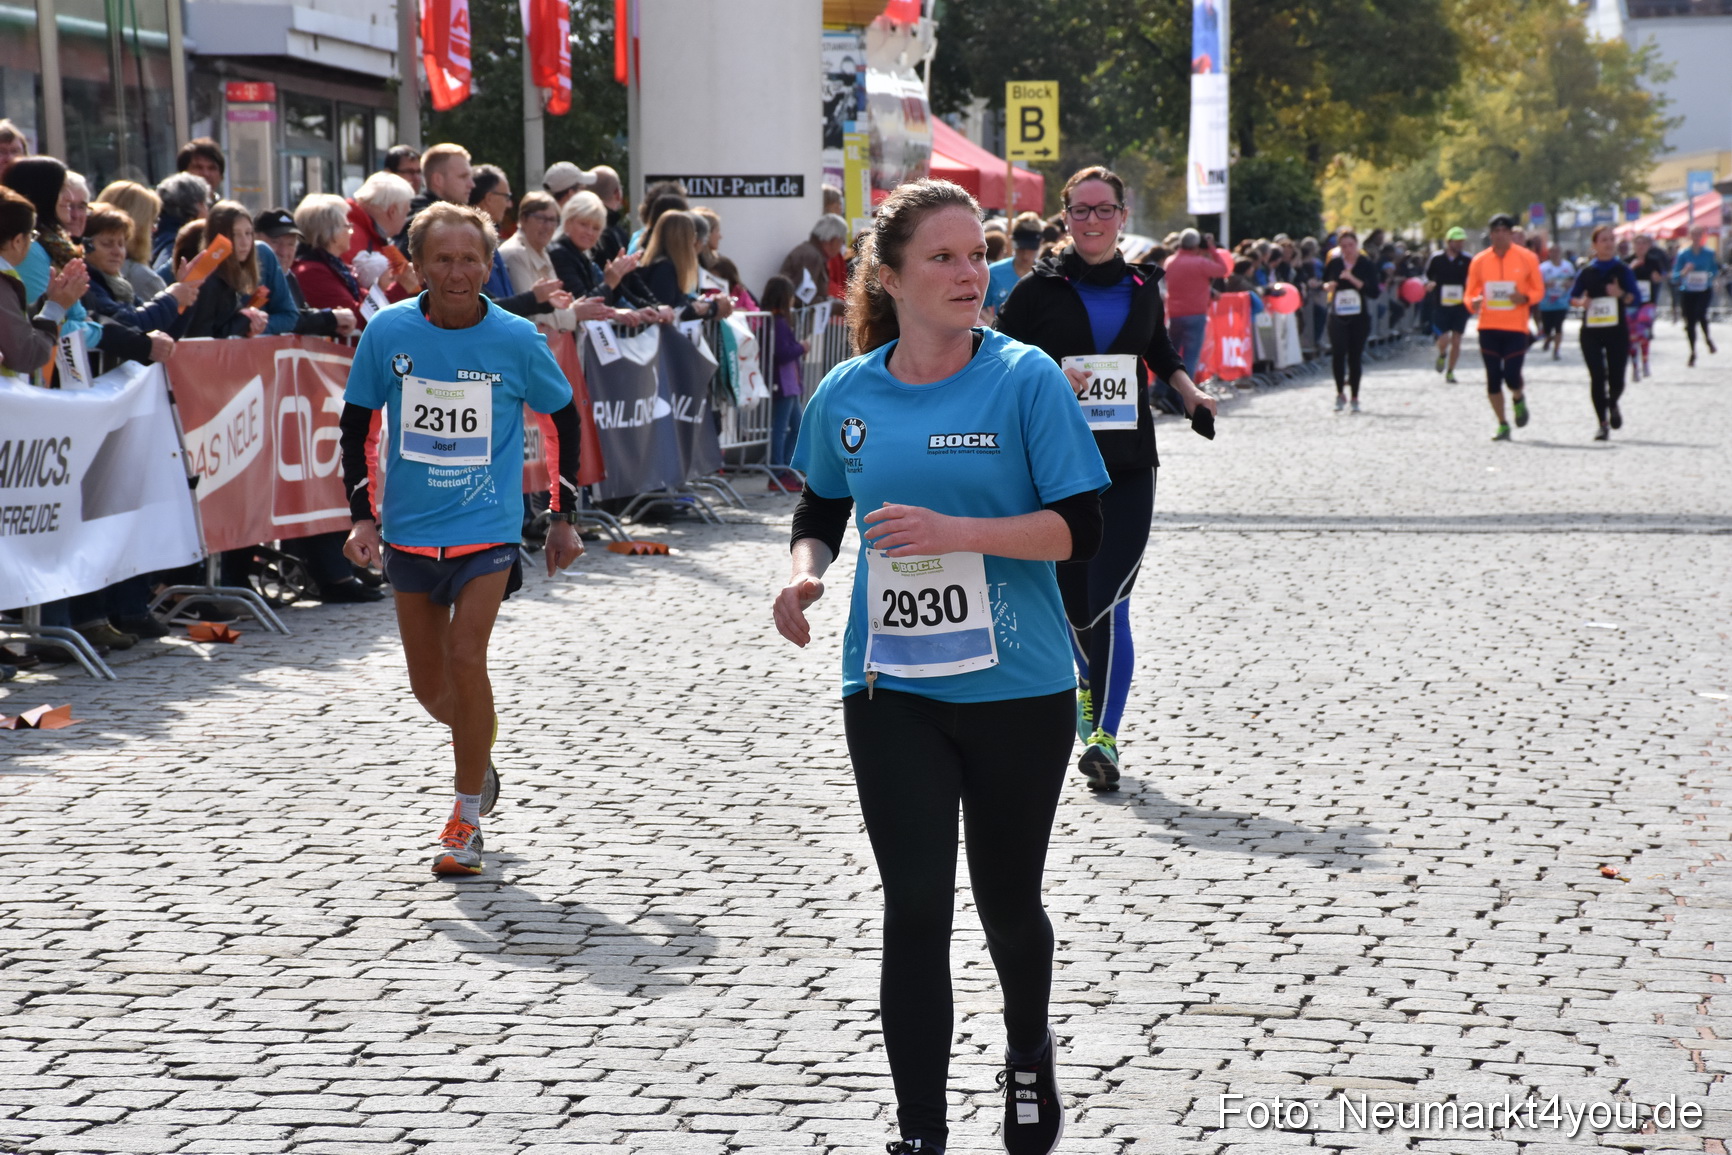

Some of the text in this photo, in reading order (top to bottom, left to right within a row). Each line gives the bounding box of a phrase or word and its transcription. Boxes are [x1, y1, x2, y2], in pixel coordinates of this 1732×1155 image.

[1013, 84, 1052, 99] Block
[1020, 106, 1045, 142] B
[646, 177, 798, 196] MINI-Partl.de
[1360, 194, 1375, 216] C
[457, 370, 502, 383] BOCK
[414, 404, 478, 433] 2316
[594, 397, 657, 430] RAIL.ON
[1091, 408, 1115, 418] Margit
[226, 398, 257, 466] NEUE
[432, 441, 456, 452] Josef
[929, 434, 998, 448] BOCK
[428, 474, 472, 488] Stadtlauf
[900, 558, 942, 572] BOCK
[882, 584, 968, 628] 2930
